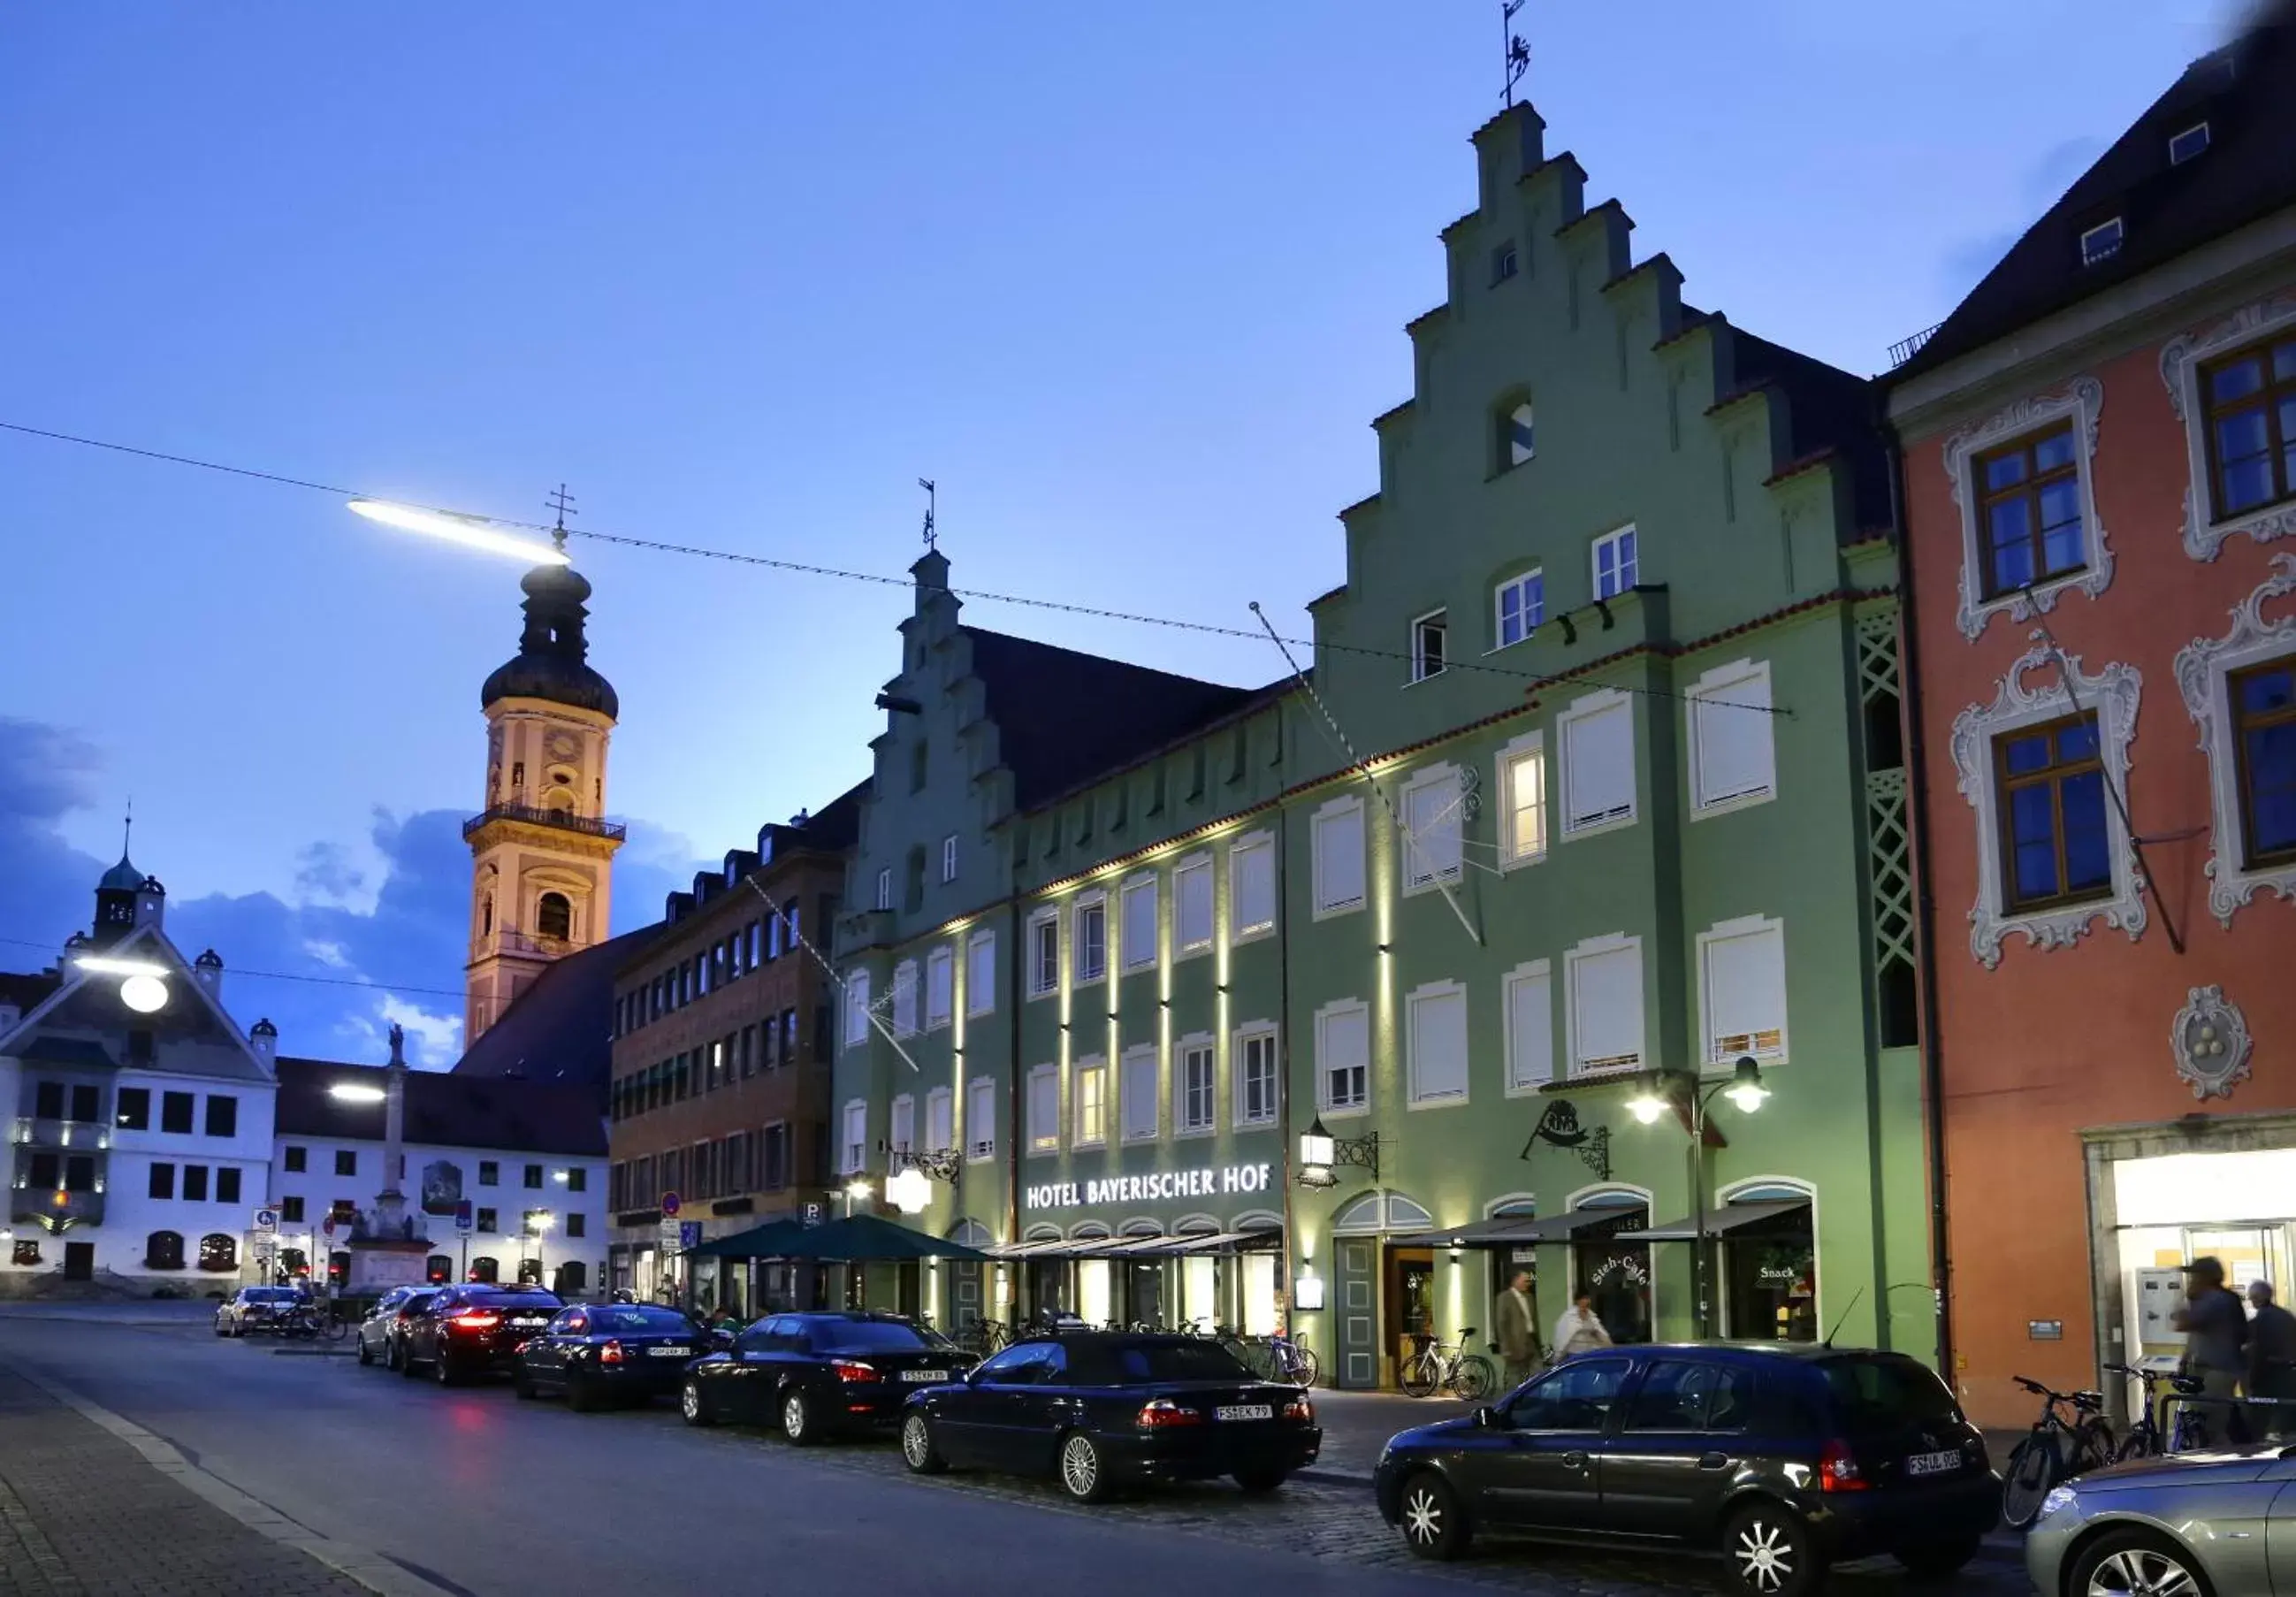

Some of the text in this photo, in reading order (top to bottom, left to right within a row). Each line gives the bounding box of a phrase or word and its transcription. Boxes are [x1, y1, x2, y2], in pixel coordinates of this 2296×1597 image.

[1027, 1162, 1271, 1210] HOTEL BAYERISCHER HOF
[1760, 1266, 1796, 1279] Snack
